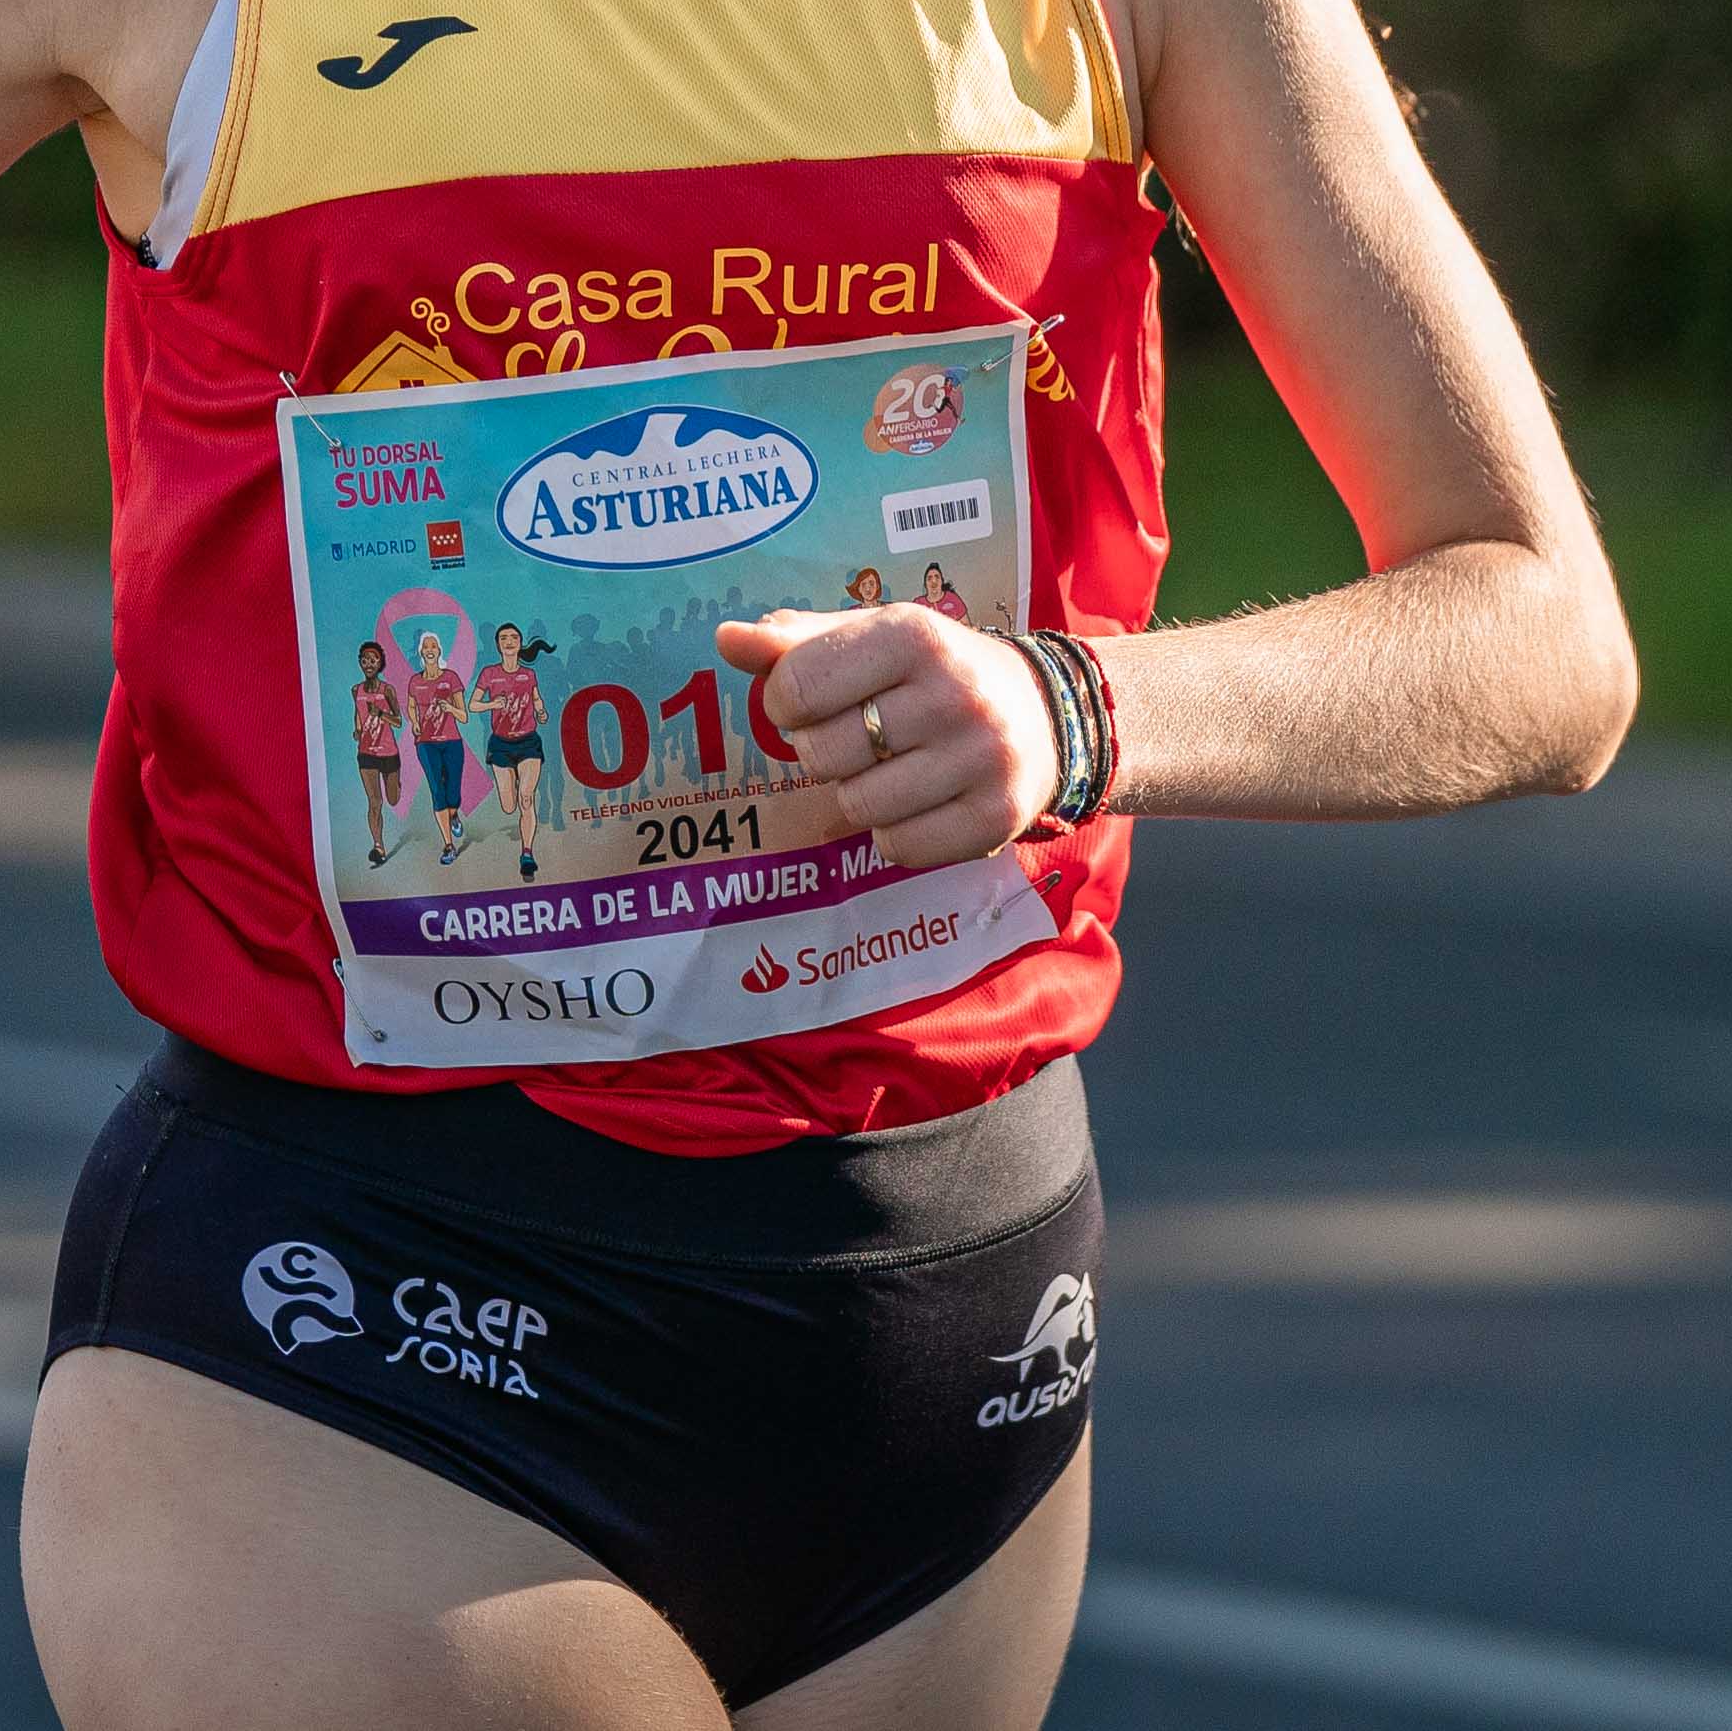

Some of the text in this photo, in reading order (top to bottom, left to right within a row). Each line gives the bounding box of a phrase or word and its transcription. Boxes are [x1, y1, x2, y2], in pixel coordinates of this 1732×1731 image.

[455, 243, 939, 335] Casa Rural
[883, 373, 946, 424] 20
[329, 441, 444, 469] TU DORSAL
[572, 442, 782, 488] CENTRAL LECHERA
[334, 466, 446, 509] SUMA
[525, 466, 800, 541] ASTURIANA
[352, 539, 417, 558] MADRID
[570, 801, 654, 822] TELÉFONO
[657, 787, 742, 809] VIOLENCIA
[746, 782, 766, 797] DE
[635, 804, 761, 866] 2041
[419, 898, 582, 942] CARRERA
[592, 888, 638, 926] DE
[649, 880, 694, 918] LA
[704, 862, 819, 910] MUJER
[796, 912, 960, 987] Santander
[433, 968, 655, 1026] OYSHO
